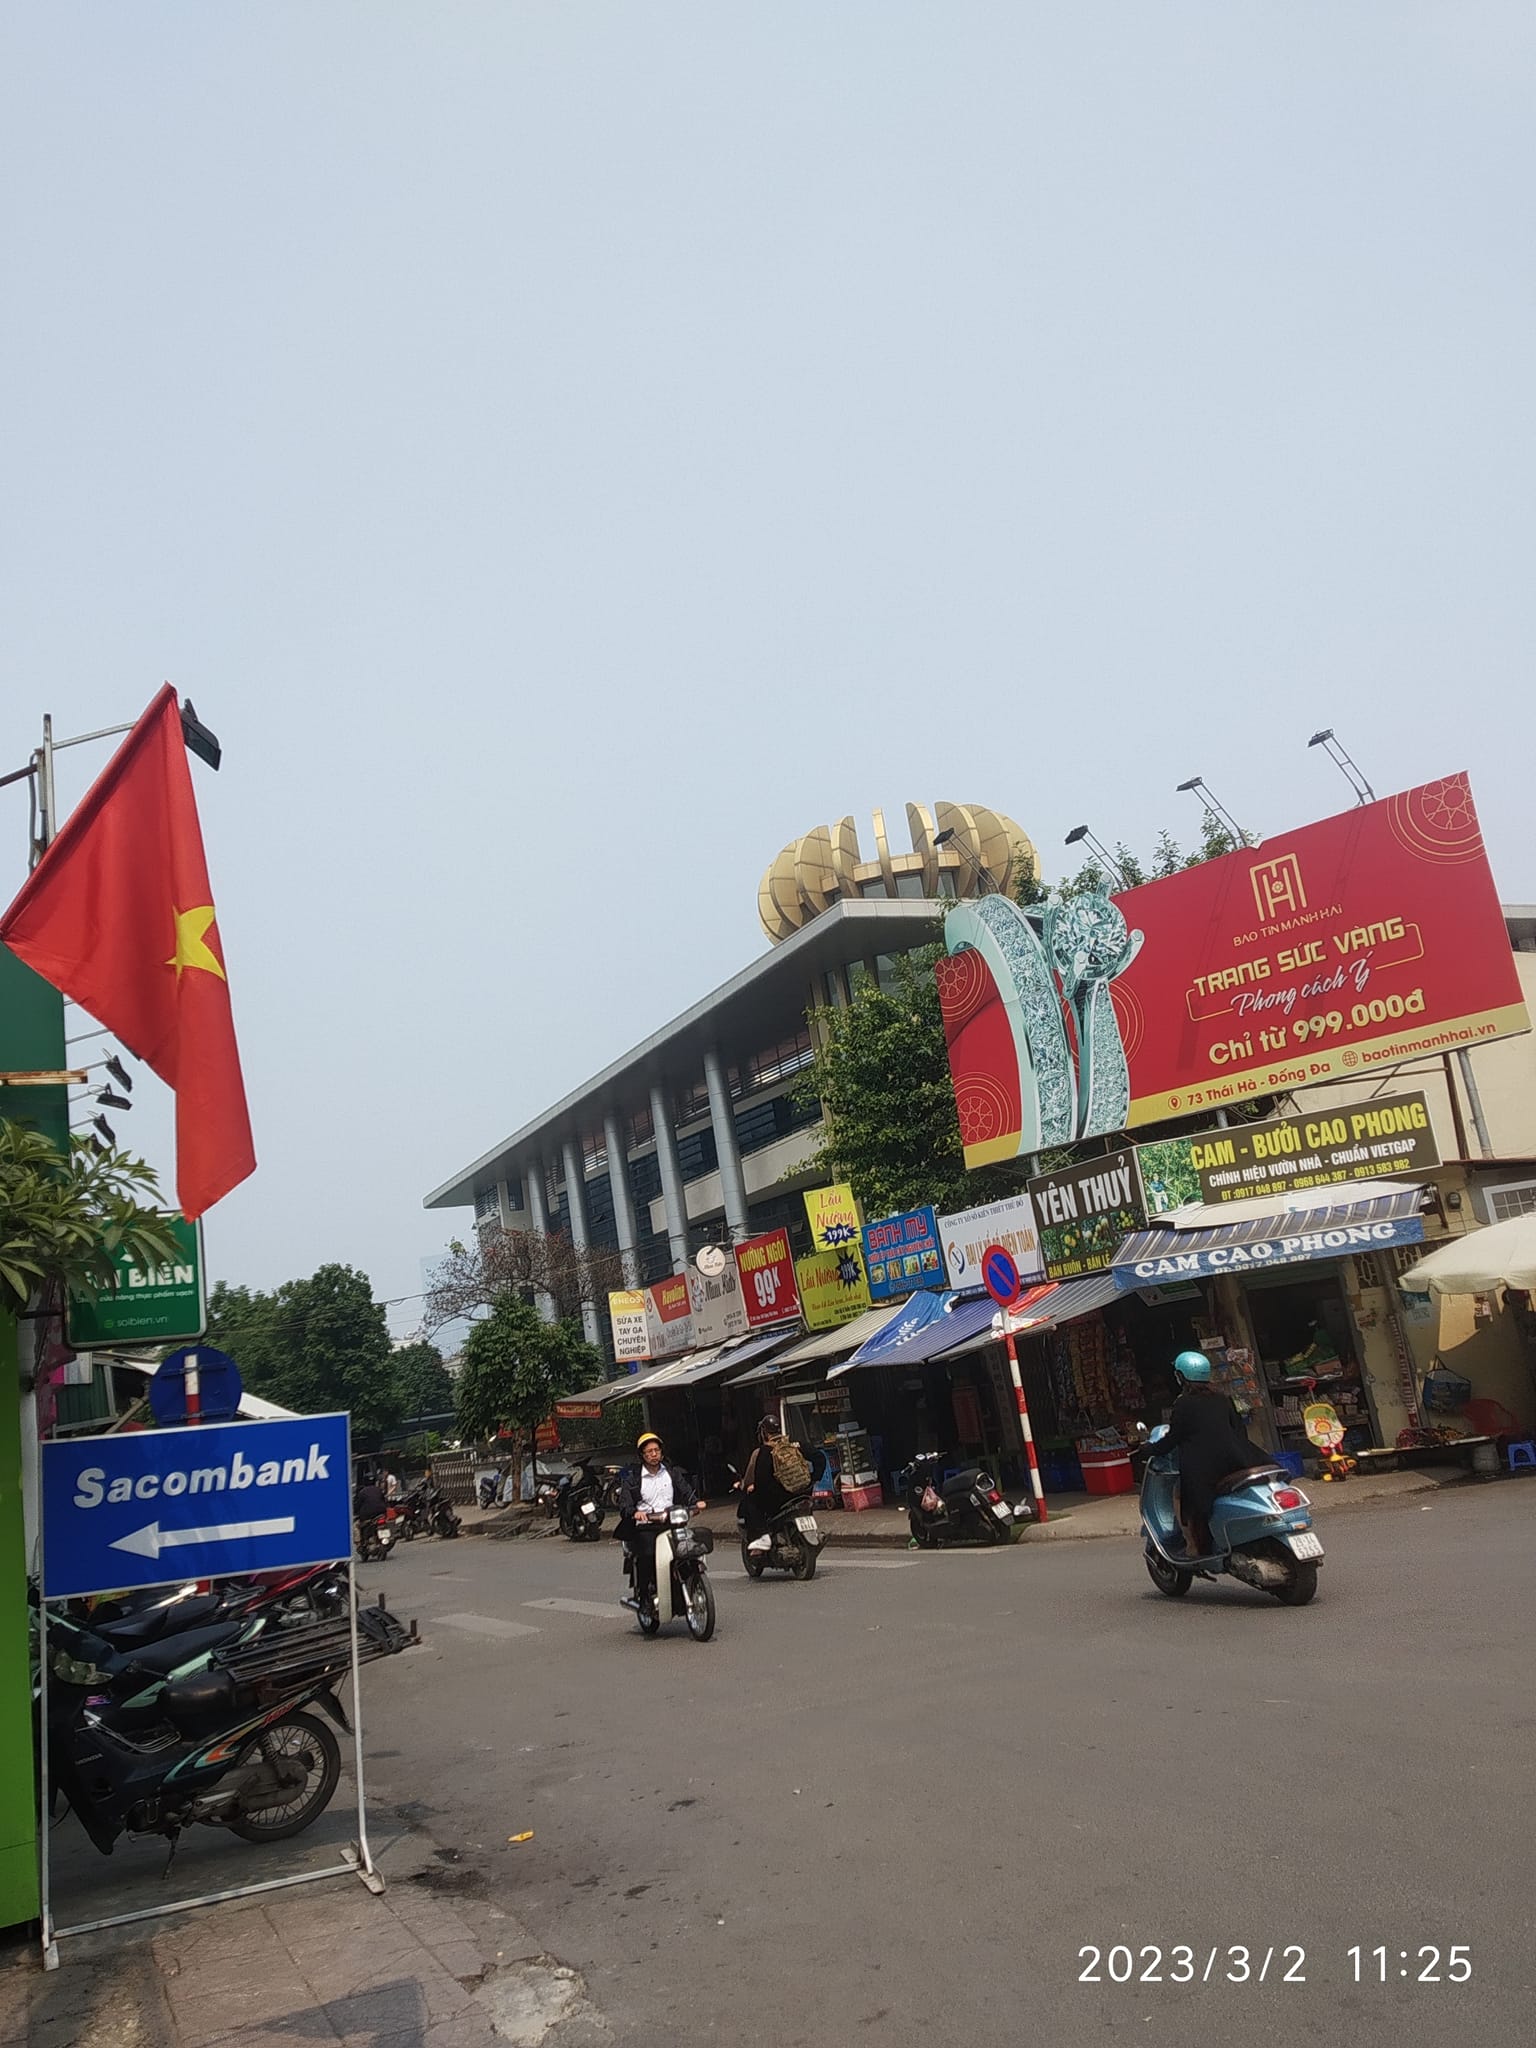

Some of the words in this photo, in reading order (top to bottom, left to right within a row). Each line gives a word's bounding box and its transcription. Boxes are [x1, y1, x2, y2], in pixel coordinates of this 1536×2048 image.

[1193, 957, 1271, 997] TRANG
[1277, 940, 1326, 973] SỨC
[1333, 917, 1406, 954] VÀNG
[1230, 987, 1297, 1016] Phong
[1301, 965, 1349, 998] cách
[1350, 950, 1373, 992] Ý
[1208, 1031, 1254, 1065] Chỉ
[1259, 1026, 1288, 1052] từ
[1292, 988, 1426, 1043] 999.000đ
[1361, 1022, 1497, 1063] baotinmanhhai.vn
[1187, 1092, 1204, 1106] 73
[1206, 1083, 1235, 1102] Thái
[1237, 1077, 1257, 1093] Hà
[1268, 1066, 1306, 1086] Đống
[1310, 1062, 1331, 1076] Đa
[1190, 1140, 1236, 1170] CAM
[1252, 1120, 1302, 1159] BƯỞI
[1305, 1118, 1348, 1149] CAO
[1350, 1103, 1427, 1140] PHONG
[1209, 1167, 1241, 1188] CHÍNH
[1242, 1162, 1267, 1183] HIỆU
[1268, 1158, 1298, 1180] VƯỜN
[1299, 1153, 1322, 1172] NHÀ
[1331, 1143, 1370, 1166] CHUẨN
[1371, 1138, 1417, 1159] VIETGAP
[1256, 1182, 1271, 1195] 048
[1272, 1180, 1287, 1191] 897
[1354, 1165, 1376, 1178] 0913
[1376, 1161, 1393, 1174] 583
[1394, 1158, 1411, 1171] 982
[819, 1189, 842, 1208] Lẩu
[1035, 1181, 1078, 1226] YÊN
[1078, 1155, 1133, 1214] THUỶ
[816, 1211, 854, 1229] Nướng
[827, 1227, 851, 1241] 199K
[867, 1221, 903, 1250] BÁNH
[944, 1217, 958, 1229] CÔNG
[957, 1216, 964, 1225] TY
[739, 1245, 767, 1273] NƯỚNG
[765, 1236, 787, 1264] NGÓI
[965, 1243, 977, 1271] ĐẠI
[1016, 1223, 1036, 1253] TOÁN
[1135, 1253, 1200, 1279] CAM
[1208, 1242, 1273, 1265] CAO
[1279, 1222, 1396, 1255] PHONG
[1049, 1262, 1063, 1279] BÁN
[1063, 1257, 1082, 1276] BUÔN
[1086, 1254, 1100, 1271] BÁN
[616, 1315, 633, 1325] SỬA
[633, 1315, 643, 1324] XE
[618, 1327, 631, 1335] TAY
[632, 1326, 643, 1335] GA
[617, 1335, 646, 1346] CHUYÊN
[619, 1346, 646, 1356] NGHIỆP
[73, 1443, 331, 1509] Sacombank
